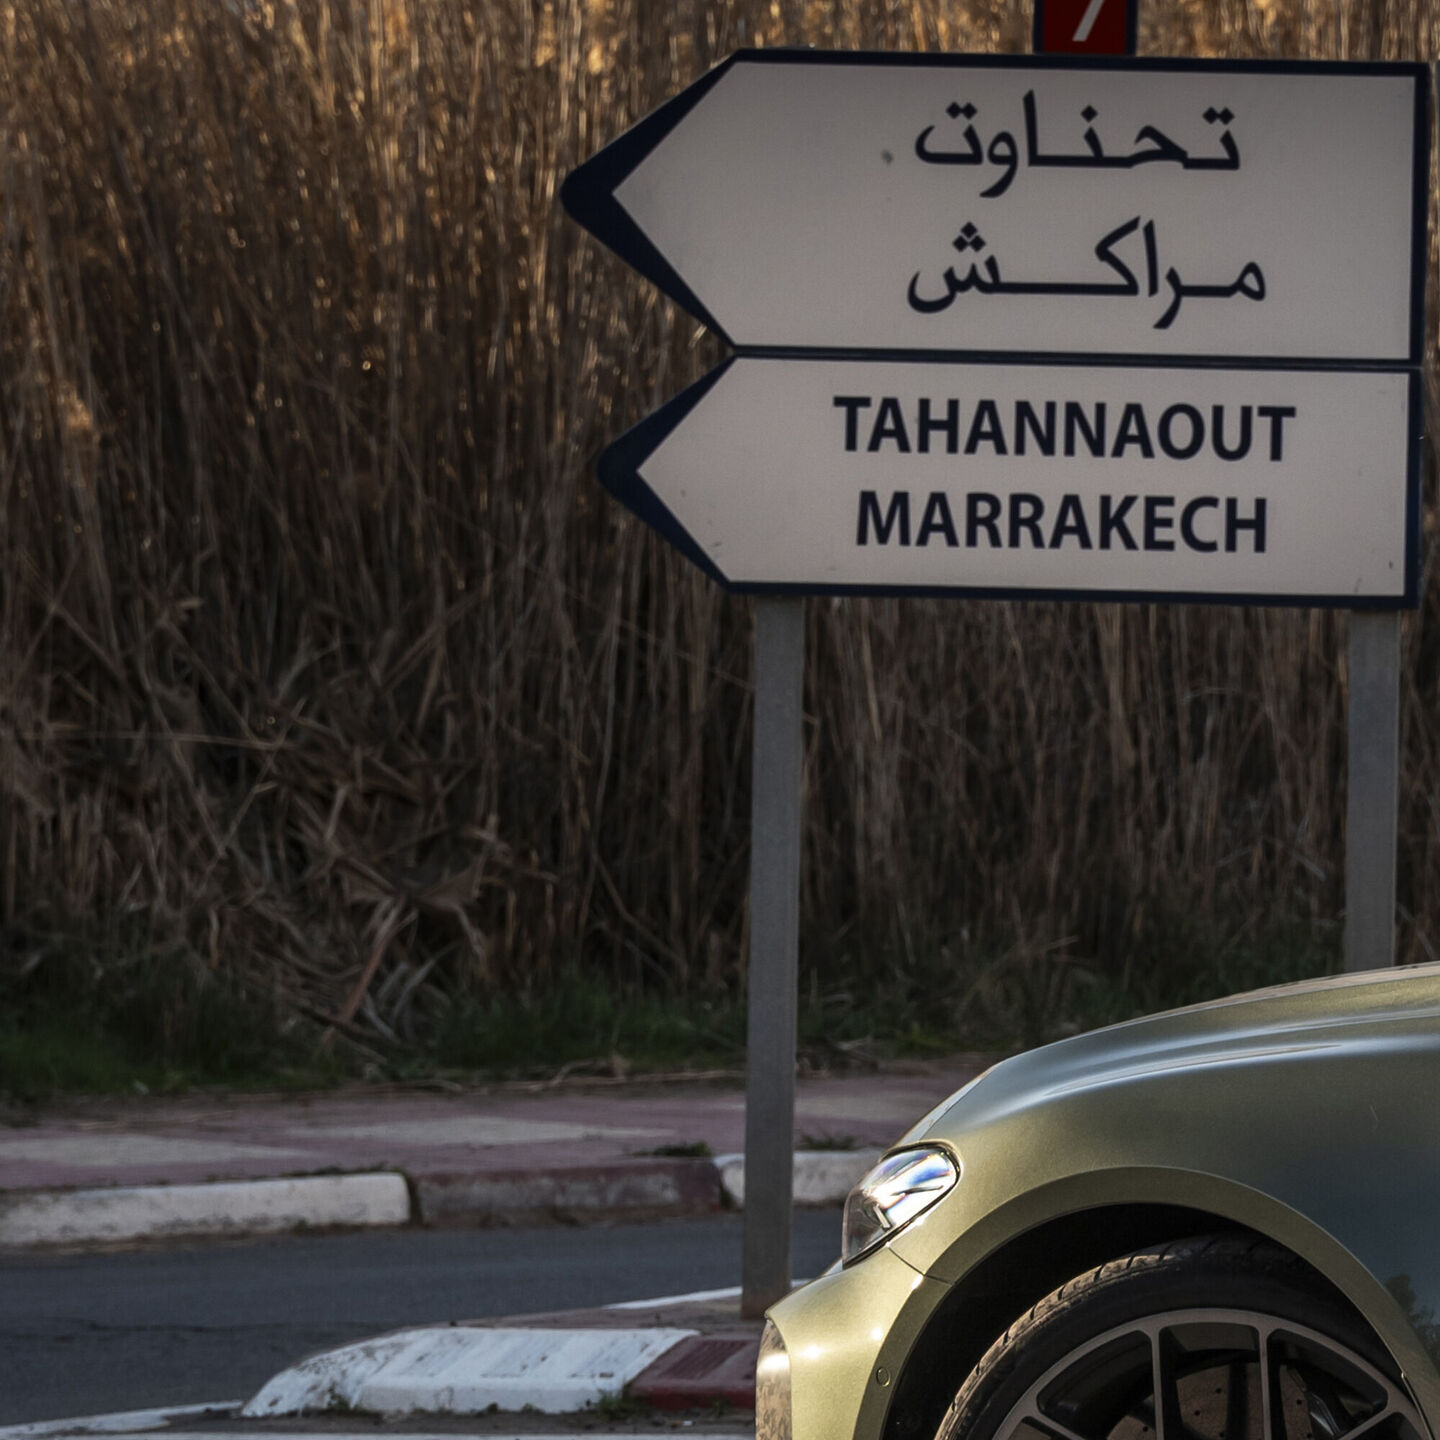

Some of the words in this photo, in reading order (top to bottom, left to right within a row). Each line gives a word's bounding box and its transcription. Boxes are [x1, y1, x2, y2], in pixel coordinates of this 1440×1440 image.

[914, 89, 1241, 198] تحناوت
[907, 215, 1266, 330] مراكش
[833, 395, 1297, 462] TAHANNAOUT
[856, 490, 1267, 554] MARRAKECH
